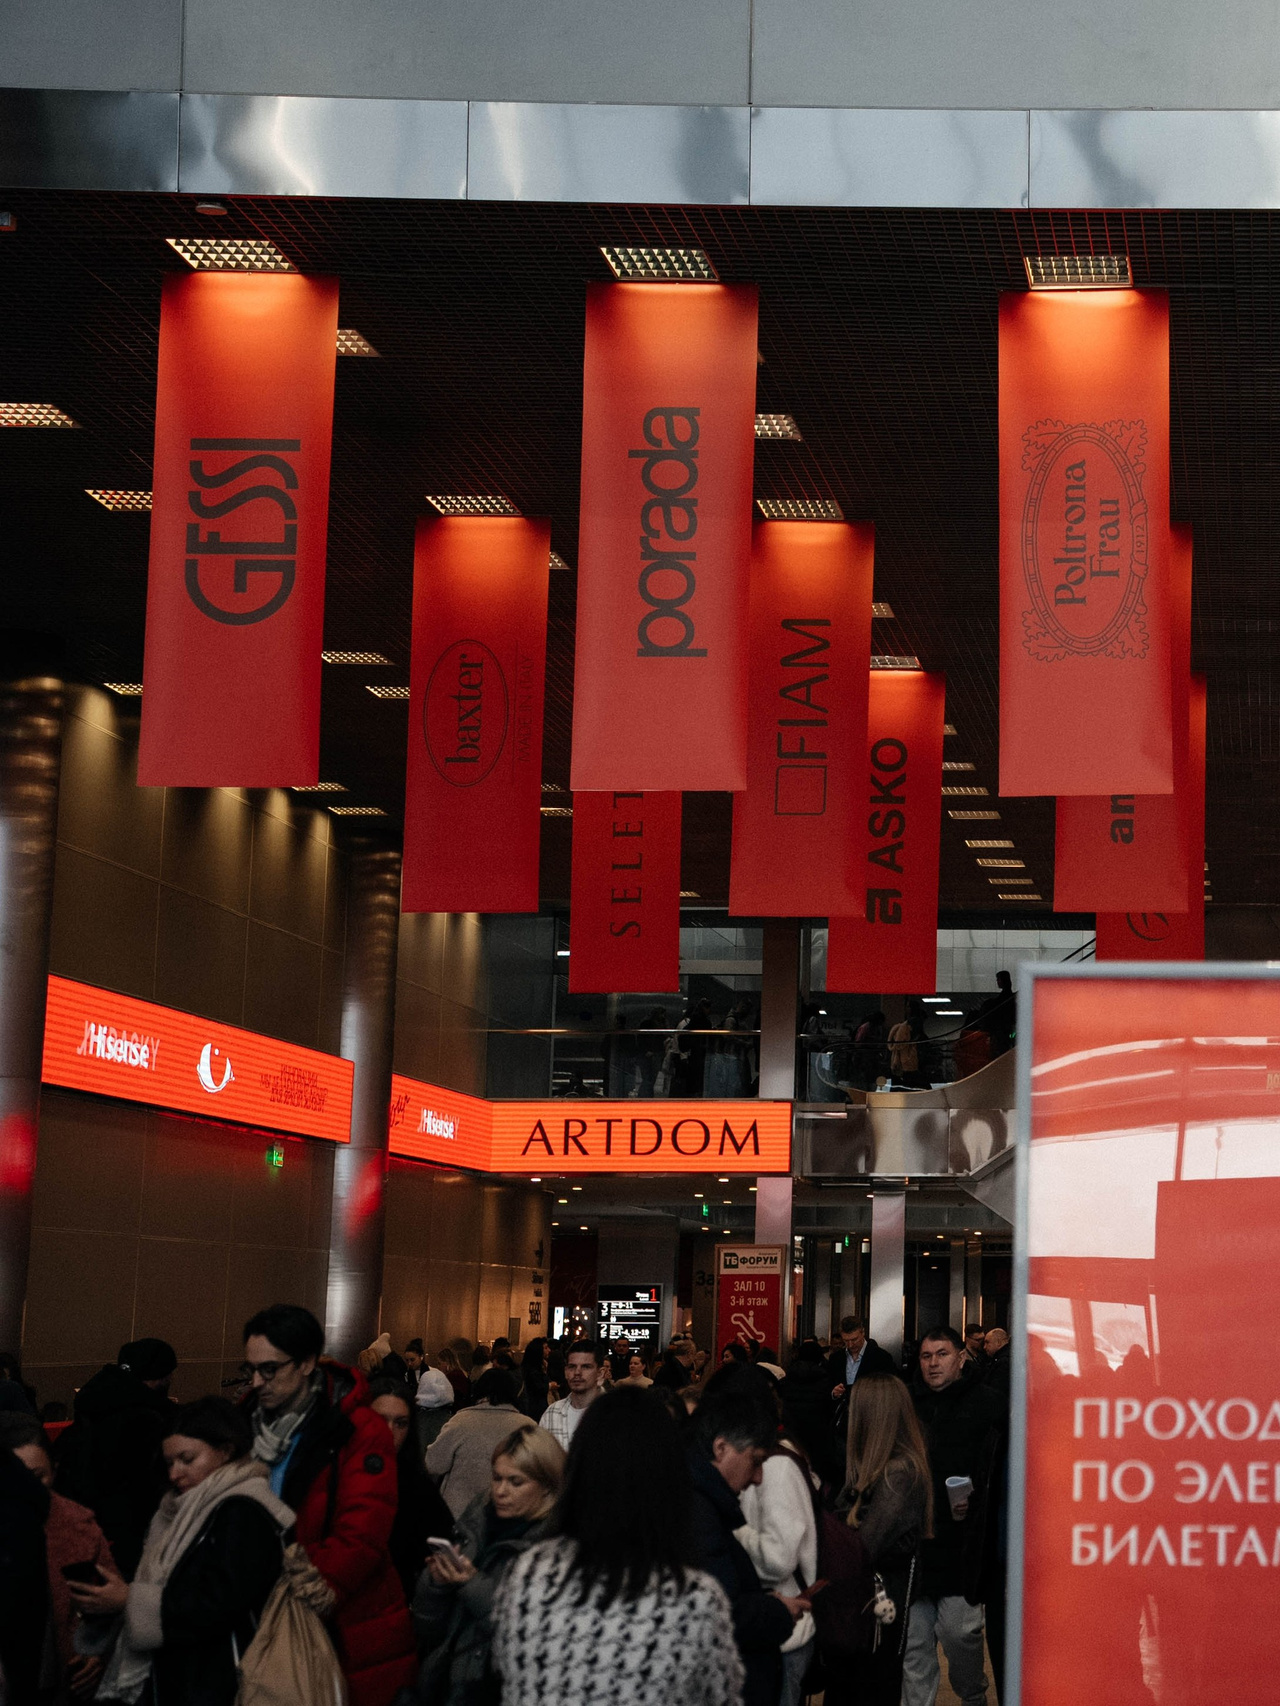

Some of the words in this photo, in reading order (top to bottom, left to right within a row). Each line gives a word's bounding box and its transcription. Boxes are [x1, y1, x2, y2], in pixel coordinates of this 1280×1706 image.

[185, 438, 300, 626] GESSI
[628, 407, 708, 657] porada
[1054, 459, 1087, 607] Poltrona
[1090, 498, 1120, 579] Frau
[1136, 523, 1145, 553] 1912
[777, 618, 831, 760] FIAM
[445, 653, 483, 767] baxter
[868, 737, 908, 874] ASKO
[88, 1021, 149, 1069] Hisense
[423, 1109, 454, 1140] Hisense
[521, 1118, 760, 1156] ARTDOM
[740, 1256, 777, 1265] ФОРУМ
[650, 1288, 657, 1302] 1
[730, 1295, 744, 1306] 3-й
[746, 1297, 769, 1306] этаж
[733, 1280, 752, 1292] ЗАЛ
[754, 1280, 765, 1292] 10
[601, 1303, 608, 1313] 3
[600, 1324, 607, 1334] 2
[1071, 1461, 1153, 1504] ПО
